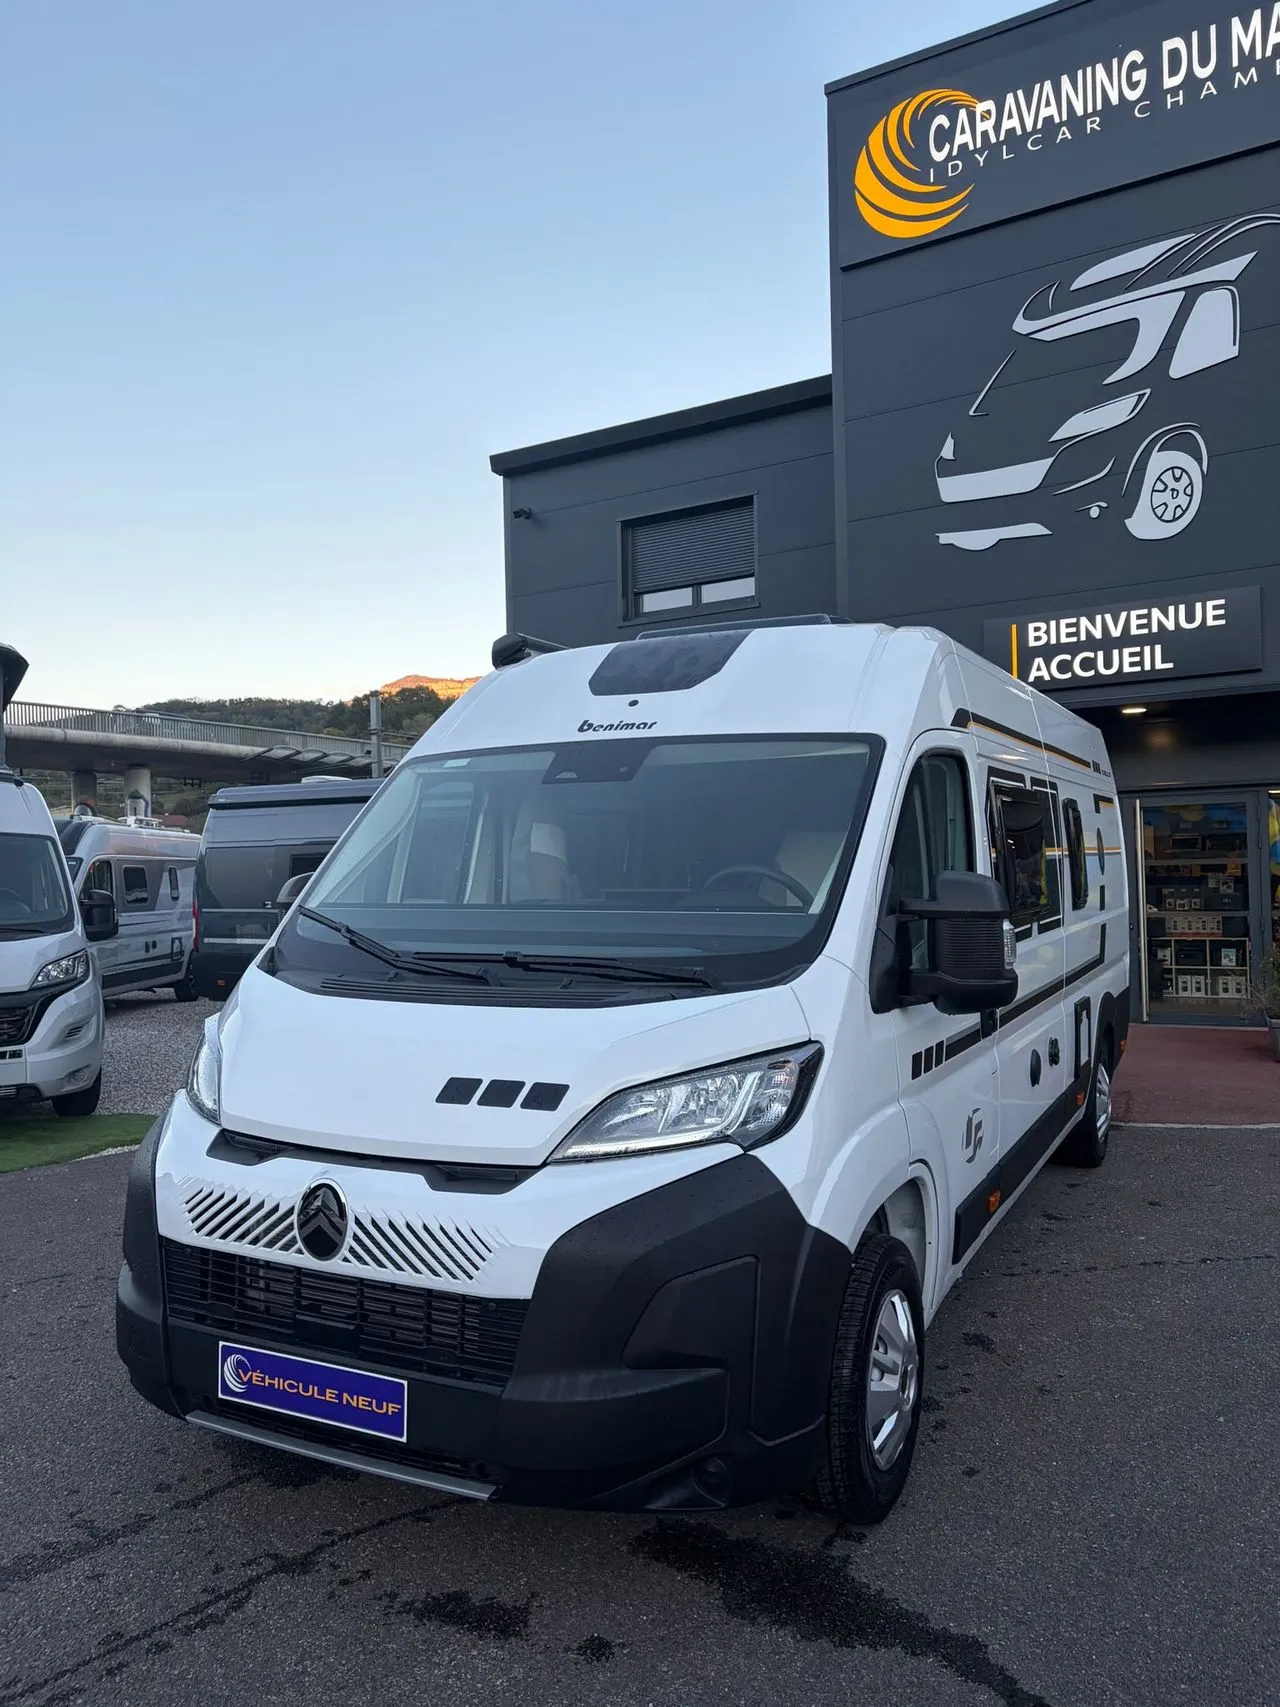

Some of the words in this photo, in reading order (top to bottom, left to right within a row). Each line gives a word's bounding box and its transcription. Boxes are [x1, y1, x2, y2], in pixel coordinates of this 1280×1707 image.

[929, 49, 1147, 162] CARAVANING
[1162, 23, 1217, 90] DU
[929, 117, 1101, 183] IDYLCAR
[1027, 598, 1226, 648] BIENVENUE
[1027, 644, 1174, 683] ACCUEIL
[577, 719, 658, 733] benimar
[238, 1368, 339, 1404] VÉHICULE
[342, 1391, 402, 1416] NEUF
